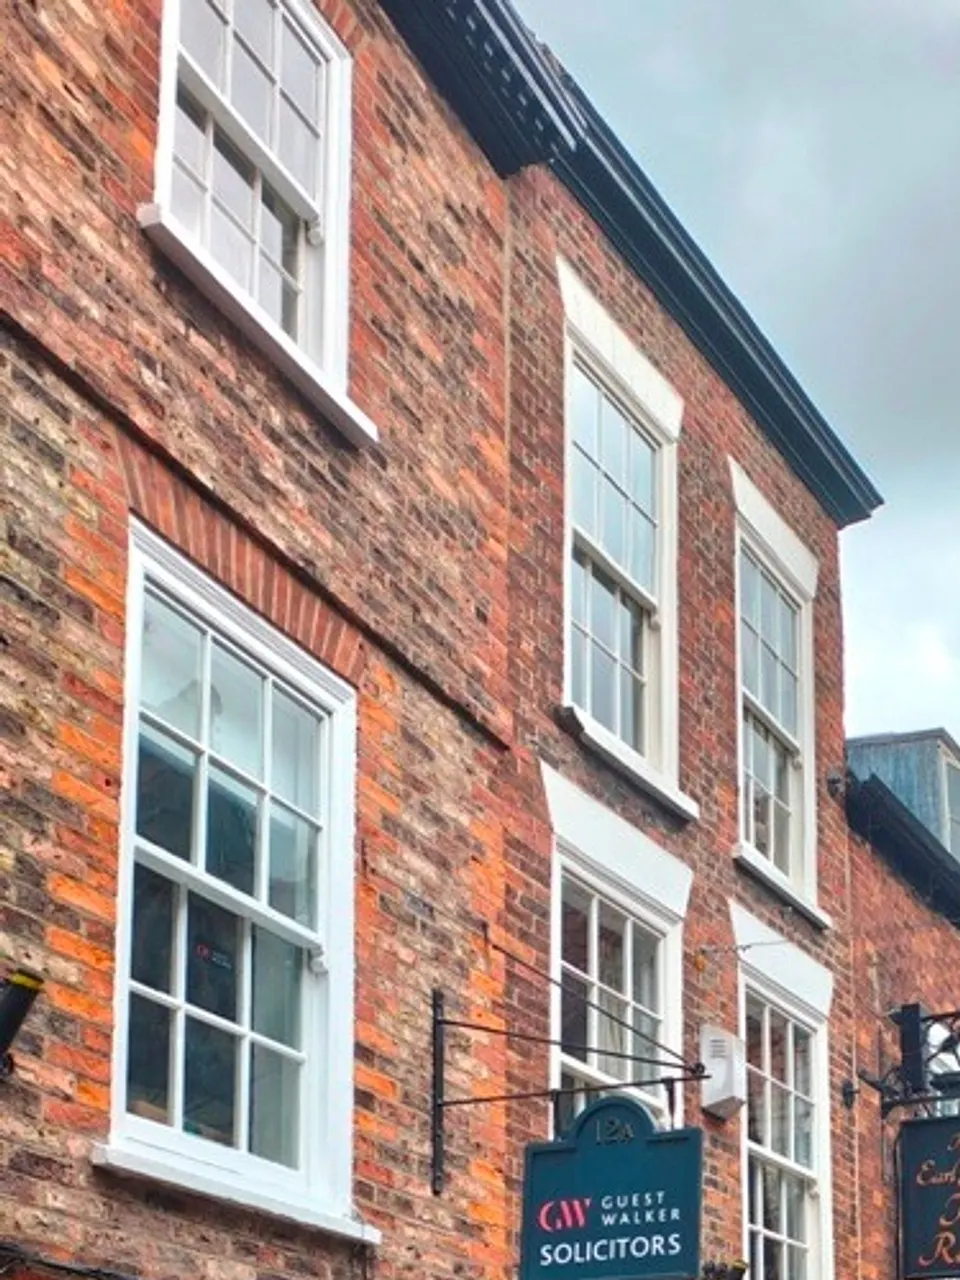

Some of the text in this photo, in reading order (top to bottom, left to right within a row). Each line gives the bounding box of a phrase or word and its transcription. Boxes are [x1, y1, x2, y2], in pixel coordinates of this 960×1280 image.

[601, 1191, 665, 1209] GUEST
[601, 1208, 681, 1226] WALKER
[540, 1233, 682, 1266] SOLICITORS
